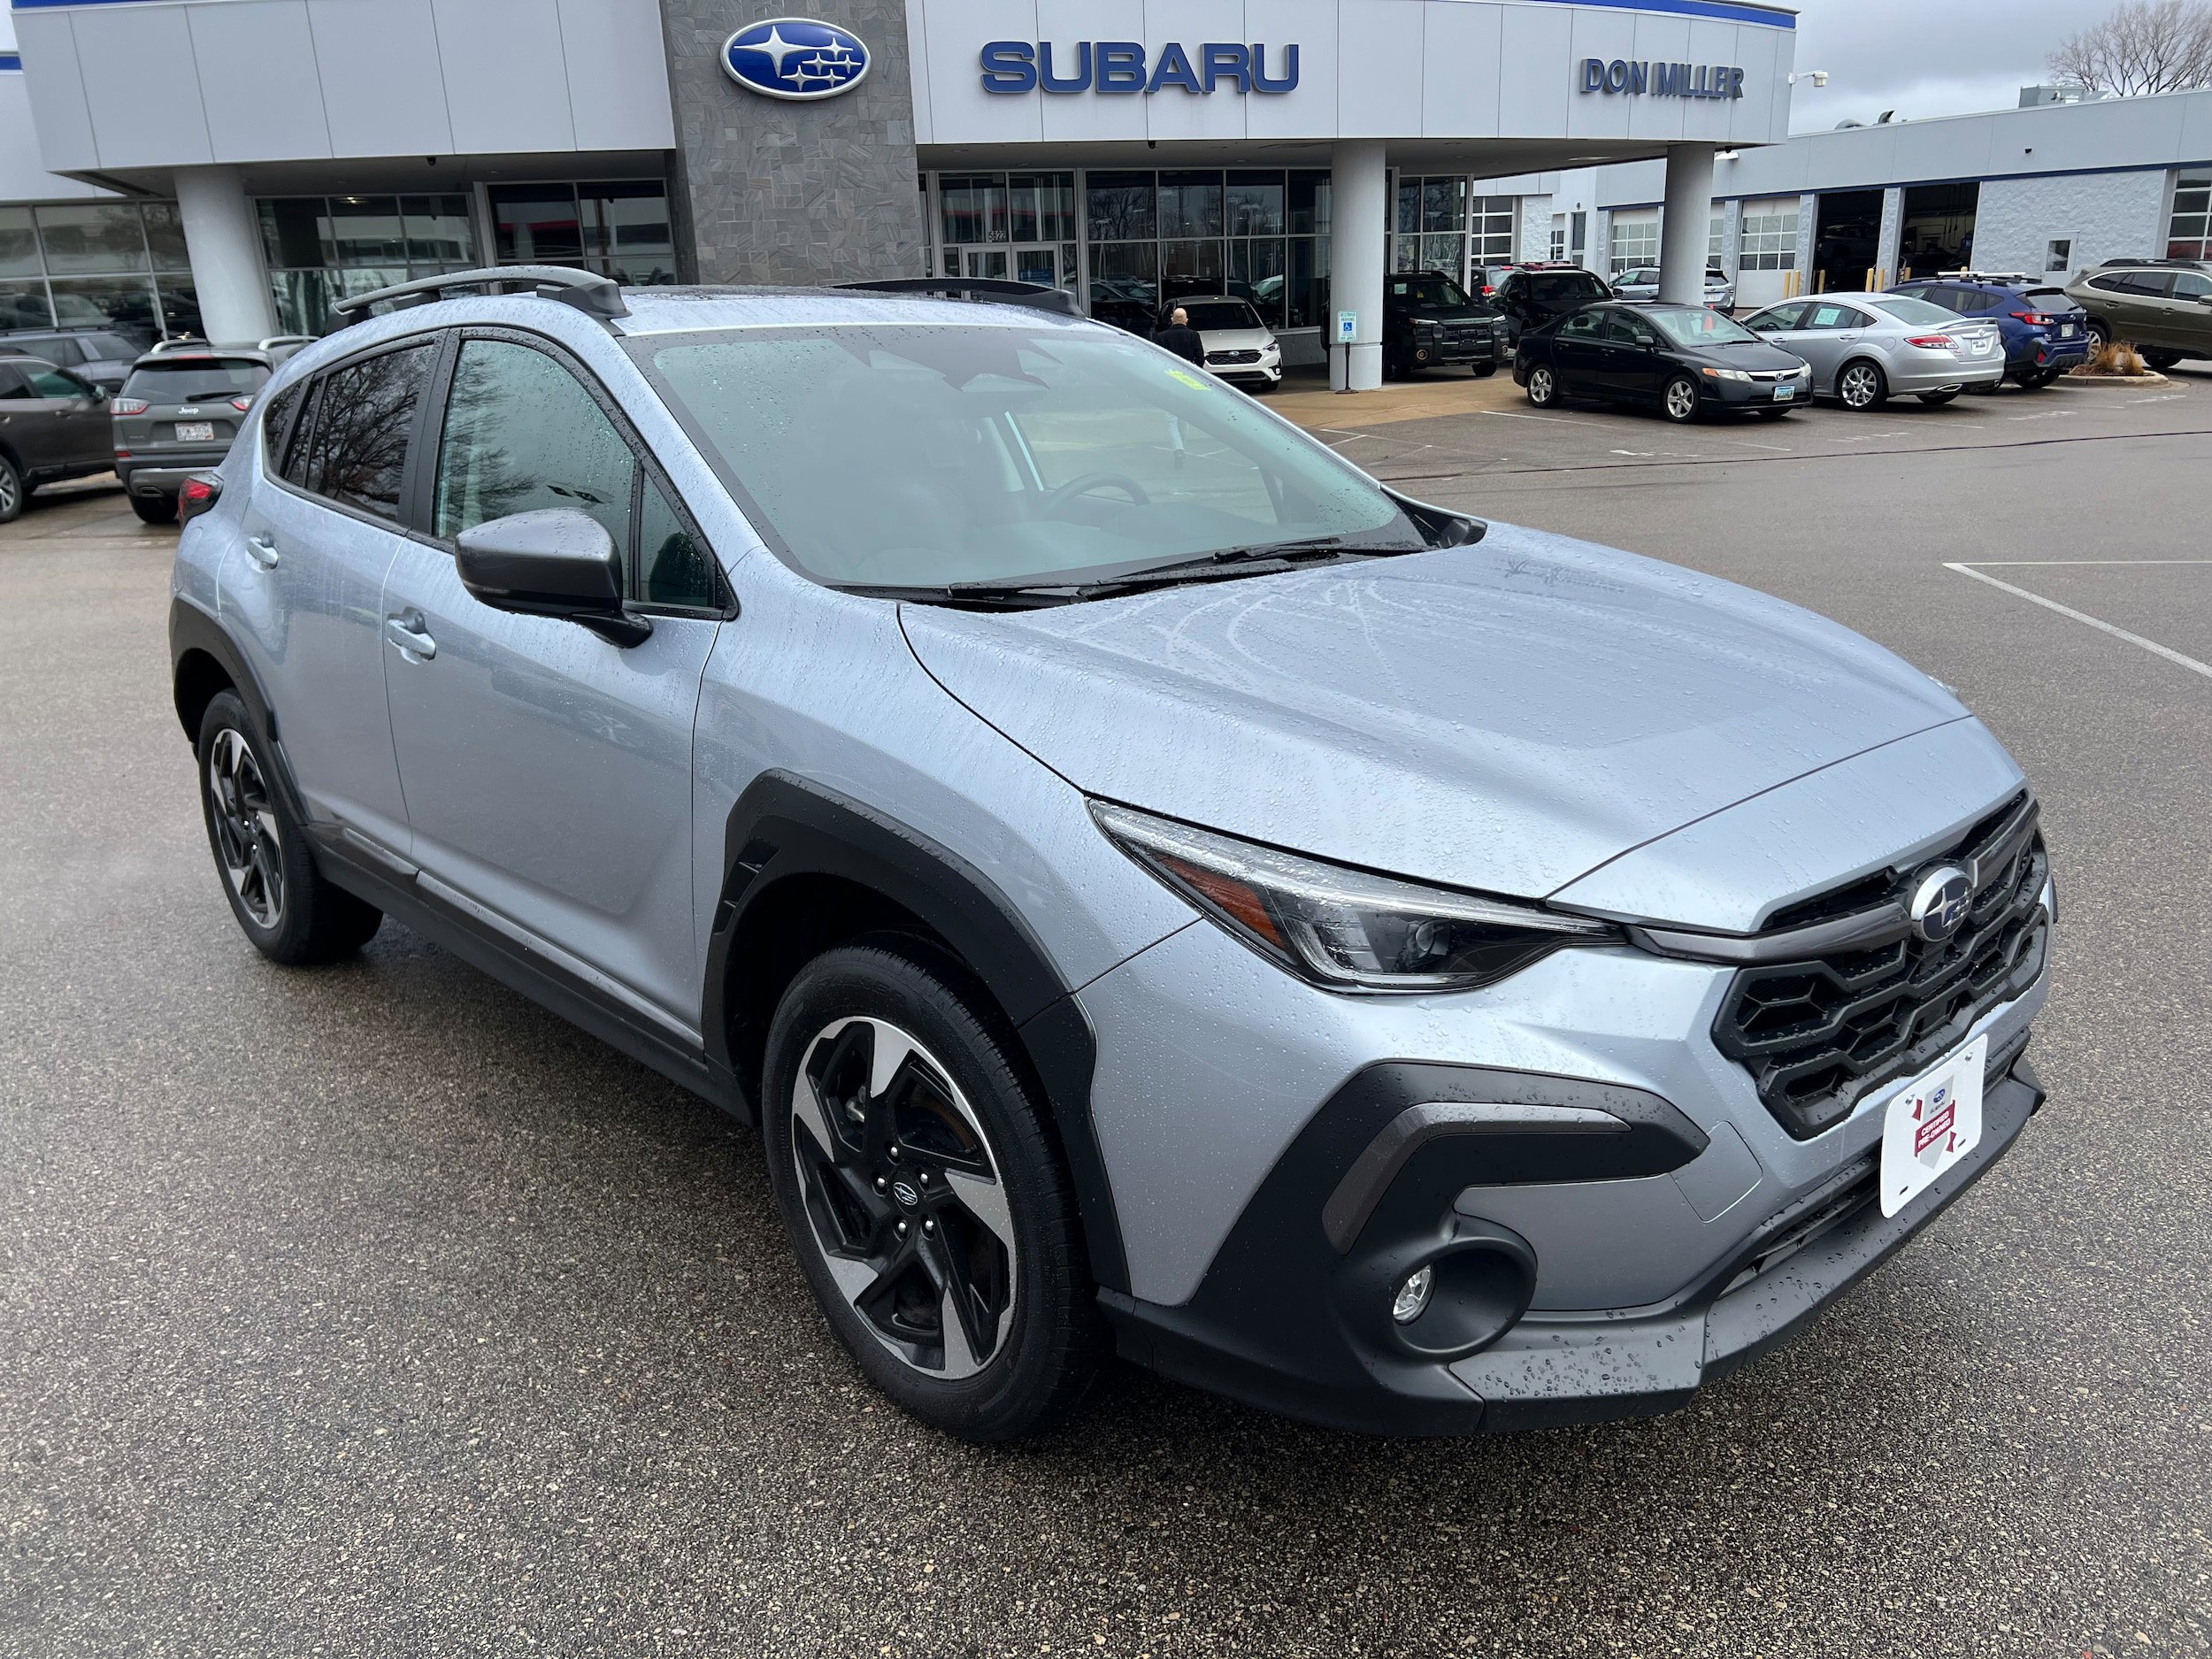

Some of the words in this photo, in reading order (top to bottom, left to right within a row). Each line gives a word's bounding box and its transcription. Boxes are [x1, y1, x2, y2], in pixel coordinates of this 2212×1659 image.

[979, 41, 1300, 93] SUBARU
[1579, 58, 1648, 95] DON
[1651, 62, 1744, 99] MILLER
[1917, 1118, 1951, 1148] PRE-OWNED
[1921, 1110, 1949, 1137] CERTIFIED
